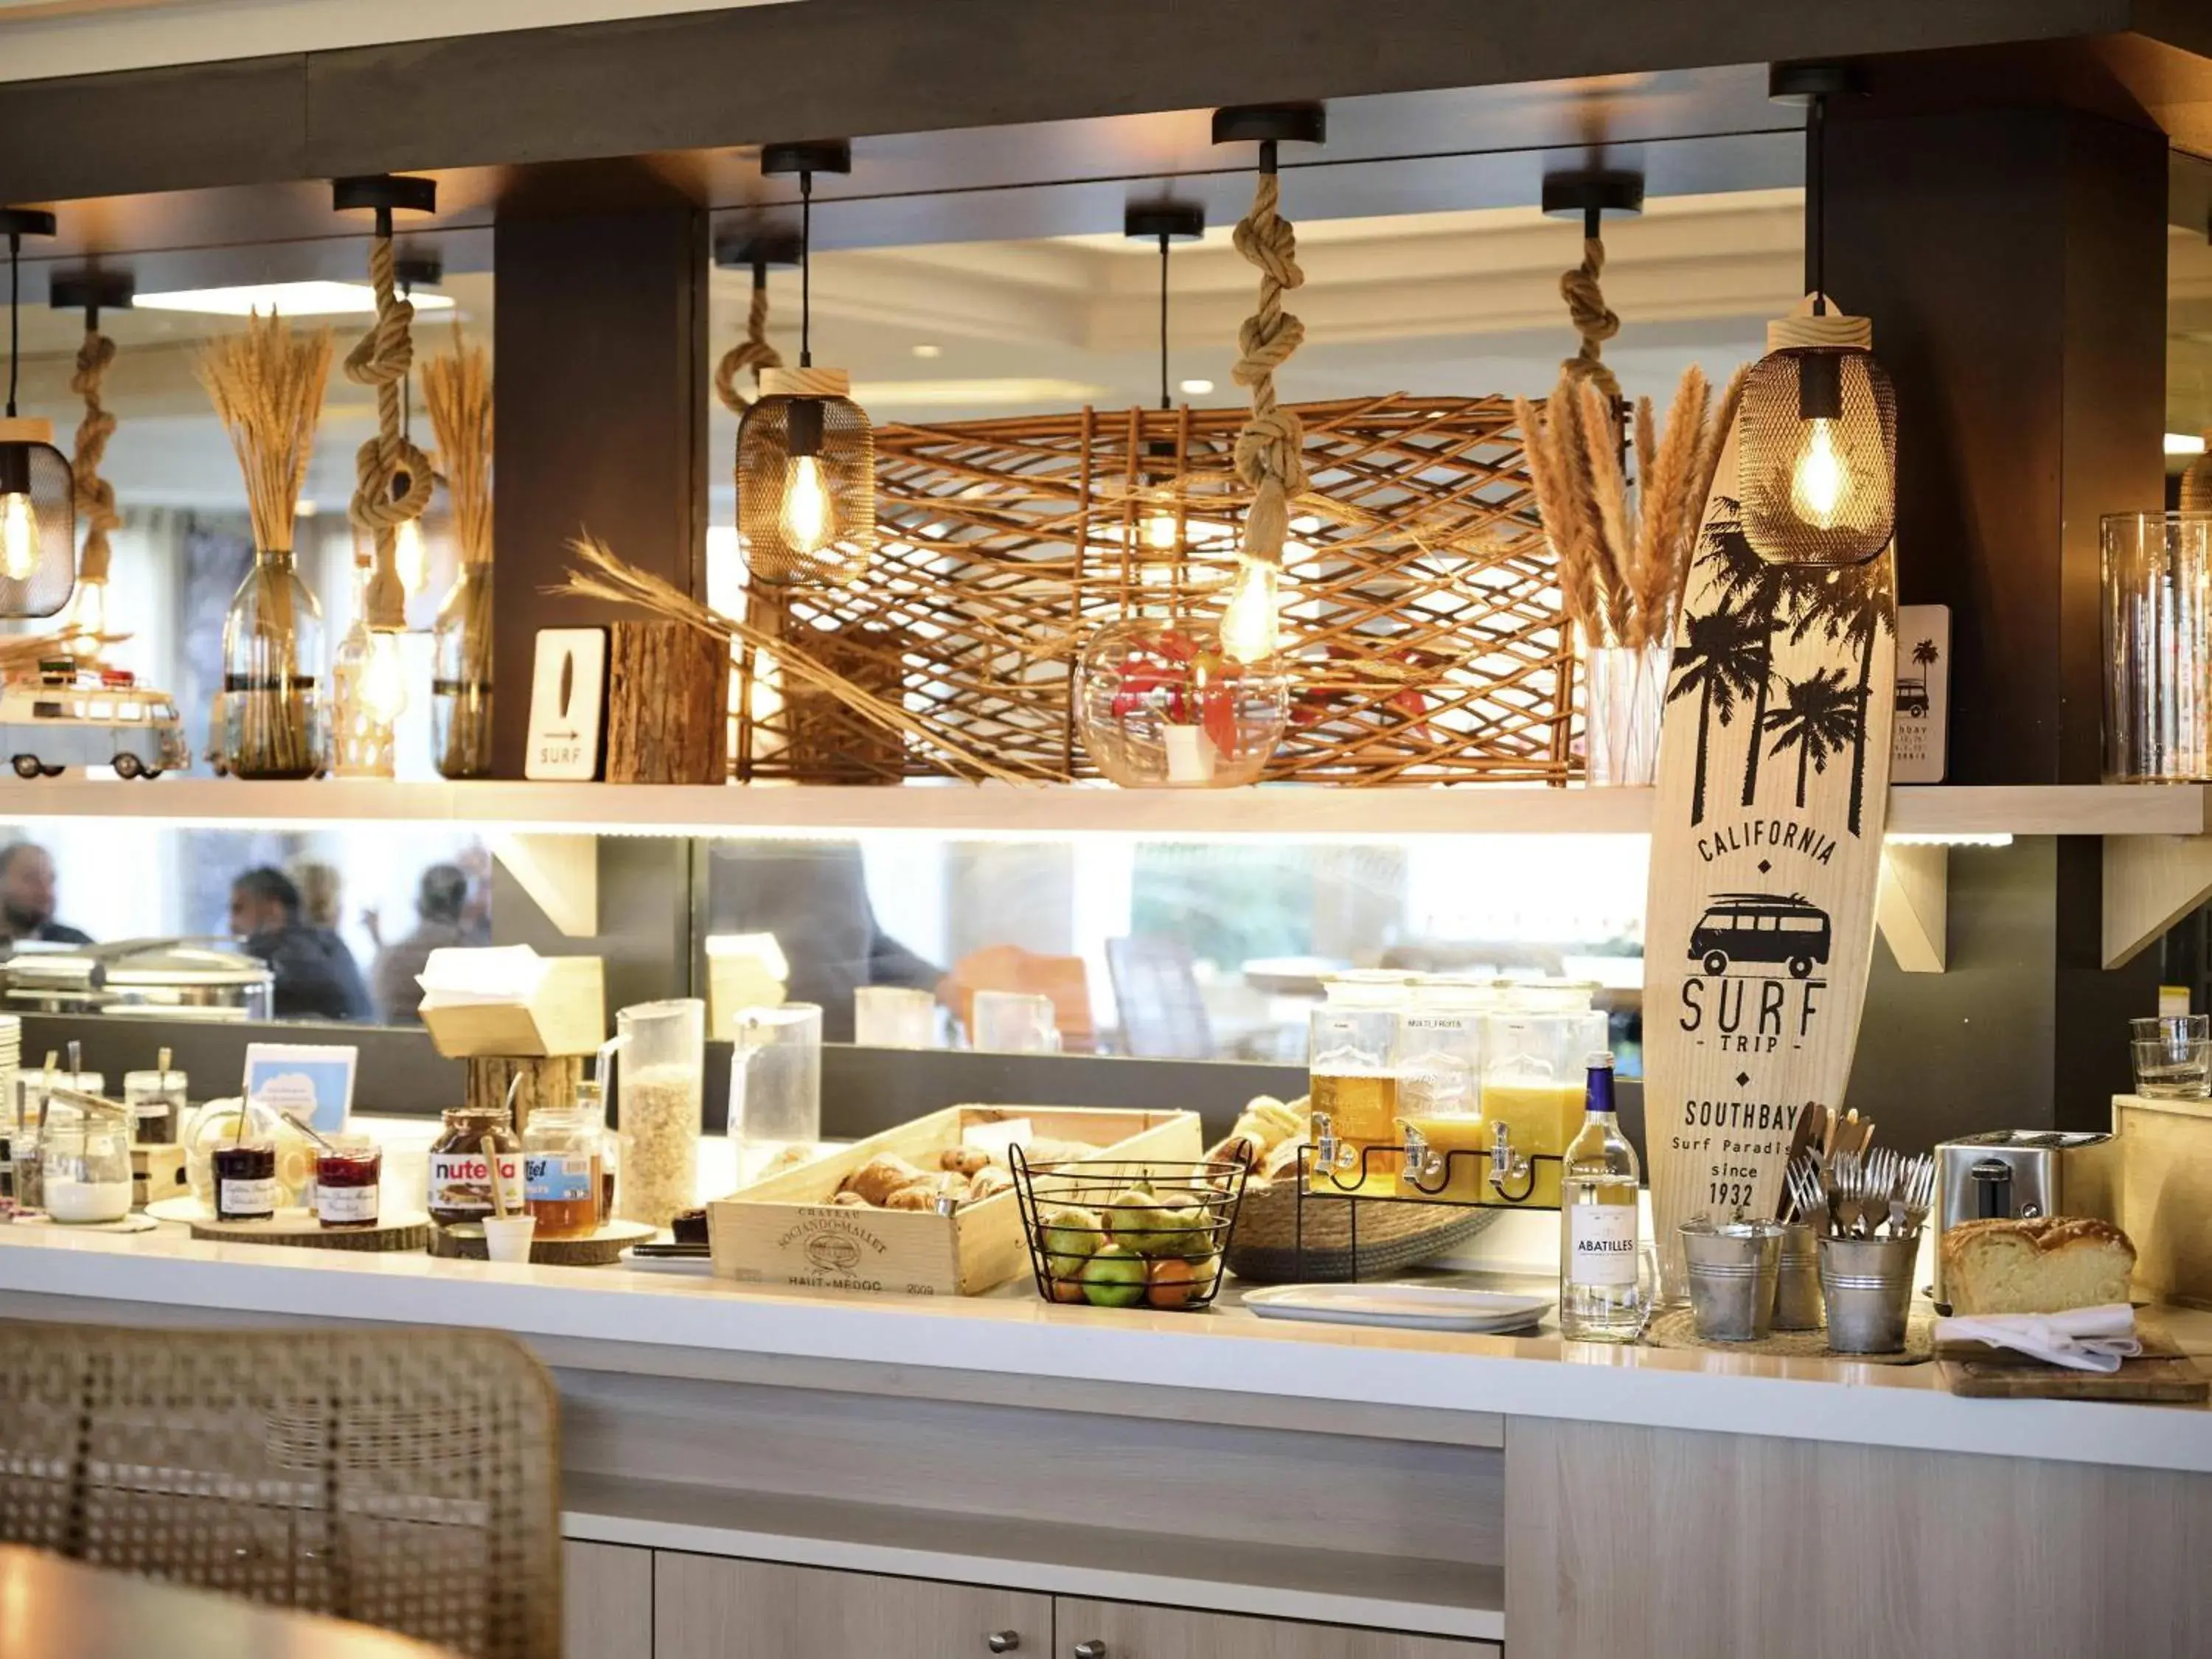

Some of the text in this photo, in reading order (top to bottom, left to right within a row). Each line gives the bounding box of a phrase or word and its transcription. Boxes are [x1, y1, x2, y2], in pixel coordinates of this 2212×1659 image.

[540, 746, 582, 765] SURF
[1697, 820, 1837, 866] CALIFORNIA
[1679, 978, 1827, 1036] SURF
[1720, 1034, 1778, 1053] TRIP
[1685, 1100, 1798, 1130] SOUTHBAY
[1672, 1135, 1792, 1155] Surf Paradis
[437, 1158, 515, 1180] nutela
[1711, 1163, 1759, 1178] since
[1710, 1182, 1753, 1207] 1932
[1578, 1239, 1634, 1251] ABATILLES
